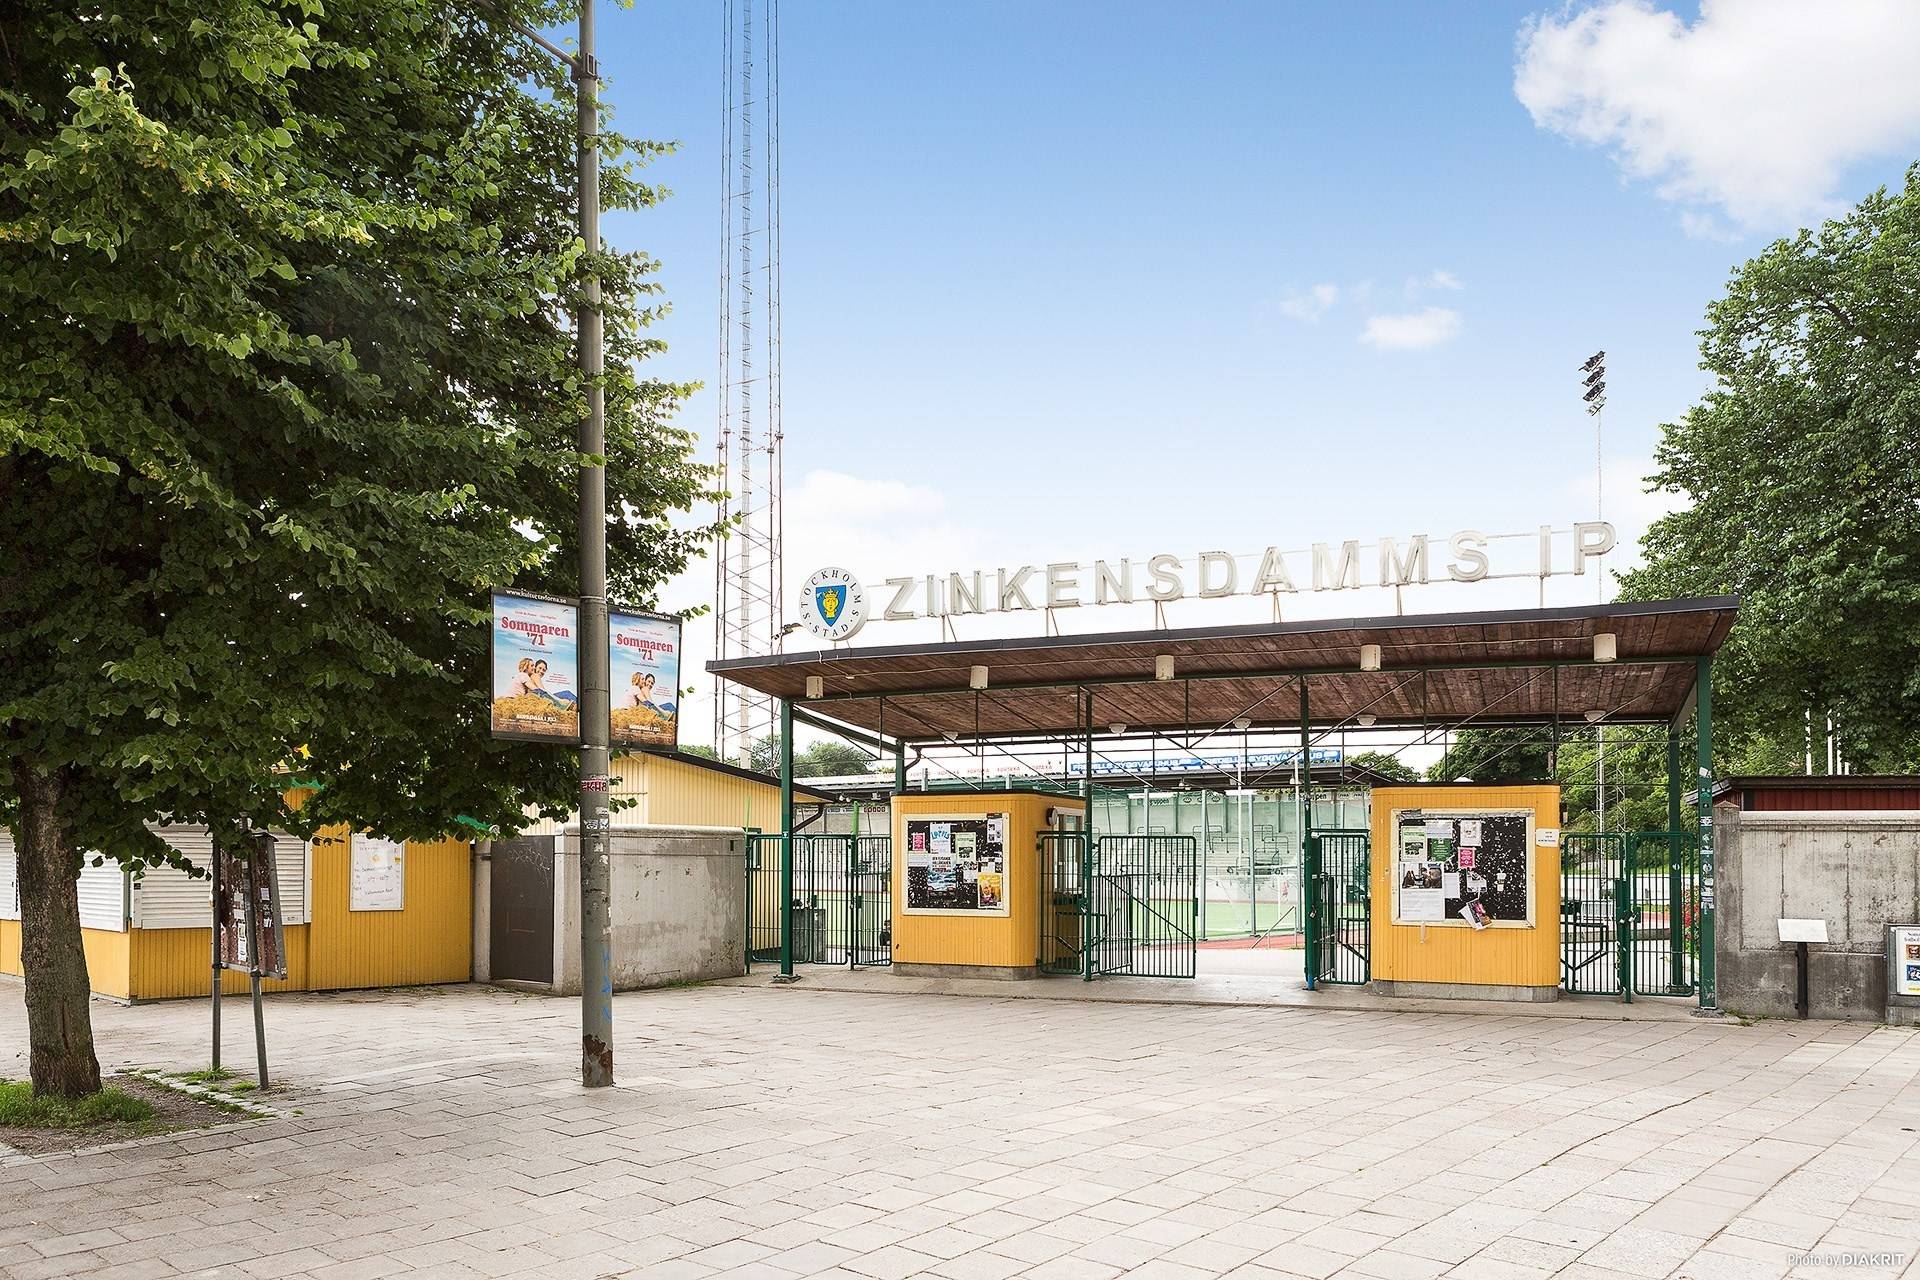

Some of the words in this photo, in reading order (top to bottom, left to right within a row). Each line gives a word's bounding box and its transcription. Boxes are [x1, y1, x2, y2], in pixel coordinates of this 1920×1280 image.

[884, 530, 1490, 621] ZINKENSDAMMS
[1539, 521, 1617, 577] IP
[801, 569, 861, 619] STOCKHOLMS
[501, 616, 570, 637] Sommaren
[812, 624, 849, 637] STAD
[616, 633, 673, 653] Sommaren
